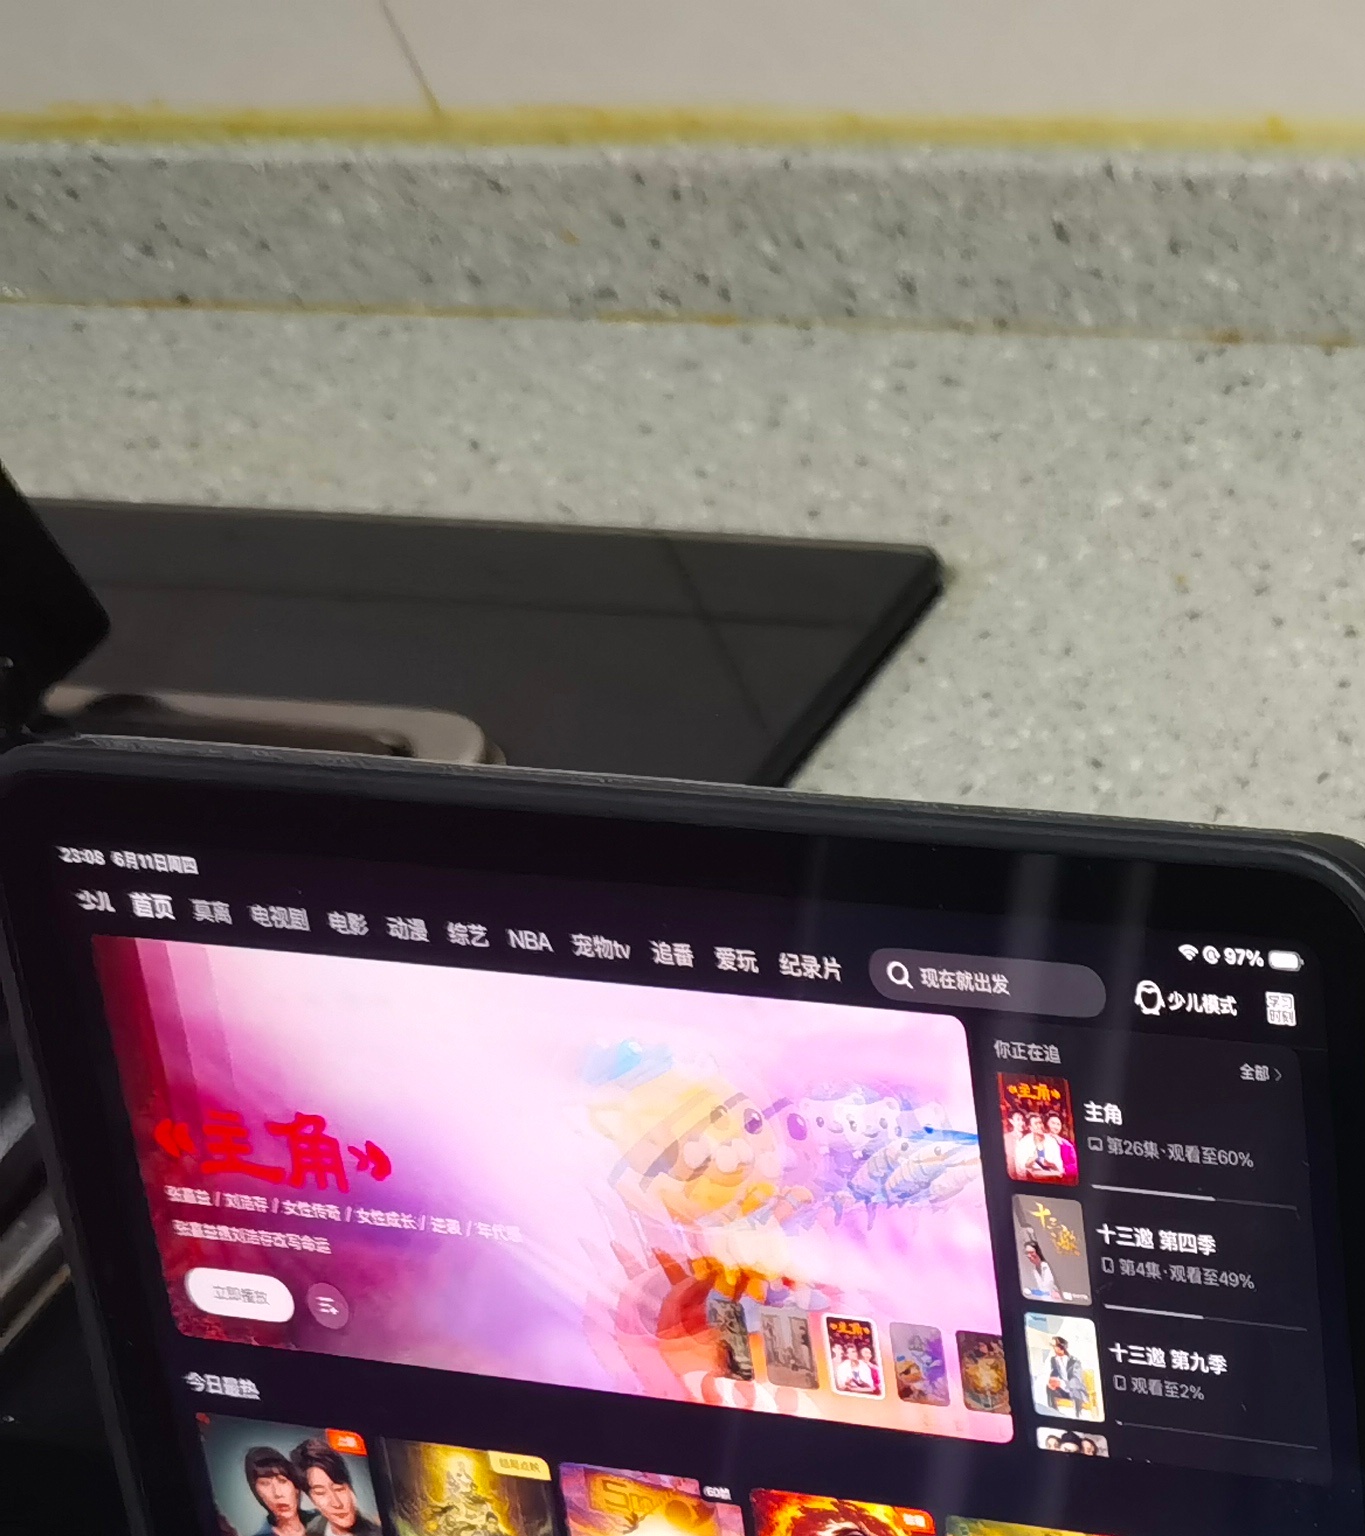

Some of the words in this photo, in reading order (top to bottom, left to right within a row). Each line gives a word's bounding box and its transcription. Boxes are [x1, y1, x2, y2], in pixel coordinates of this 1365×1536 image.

[128, 892, 176, 920] 首页
[249, 904, 311, 931] 电视剧
[327, 911, 369, 936] 电影
[386, 916, 430, 942] 动漫
[446, 921, 490, 948] 综艺
[506, 928, 554, 953] NBA
[570, 933, 631, 960] 宠物tv
[649, 940, 695, 969] 追番
[714, 946, 759, 975] 爱玩
[778, 951, 842, 982] 纪录片
[1224, 946, 1265, 968] 97%
[920, 966, 1010, 996] 现在就出发
[1168, 991, 1238, 1017] 少儿模式
[994, 1039, 1061, 1064] 你正在追
[1240, 1063, 1270, 1082] 全部
[1083, 1101, 1123, 1126] 主角
[1096, 1223, 1154, 1250] 十三邀
[1159, 1230, 1217, 1256] 第四季
[1110, 1343, 1166, 1369] 十三邀
[1170, 1348, 1228, 1375] 第九季
[183, 1371, 261, 1400] 今日最热
[1131, 1377, 1205, 1401] 观看至2%
